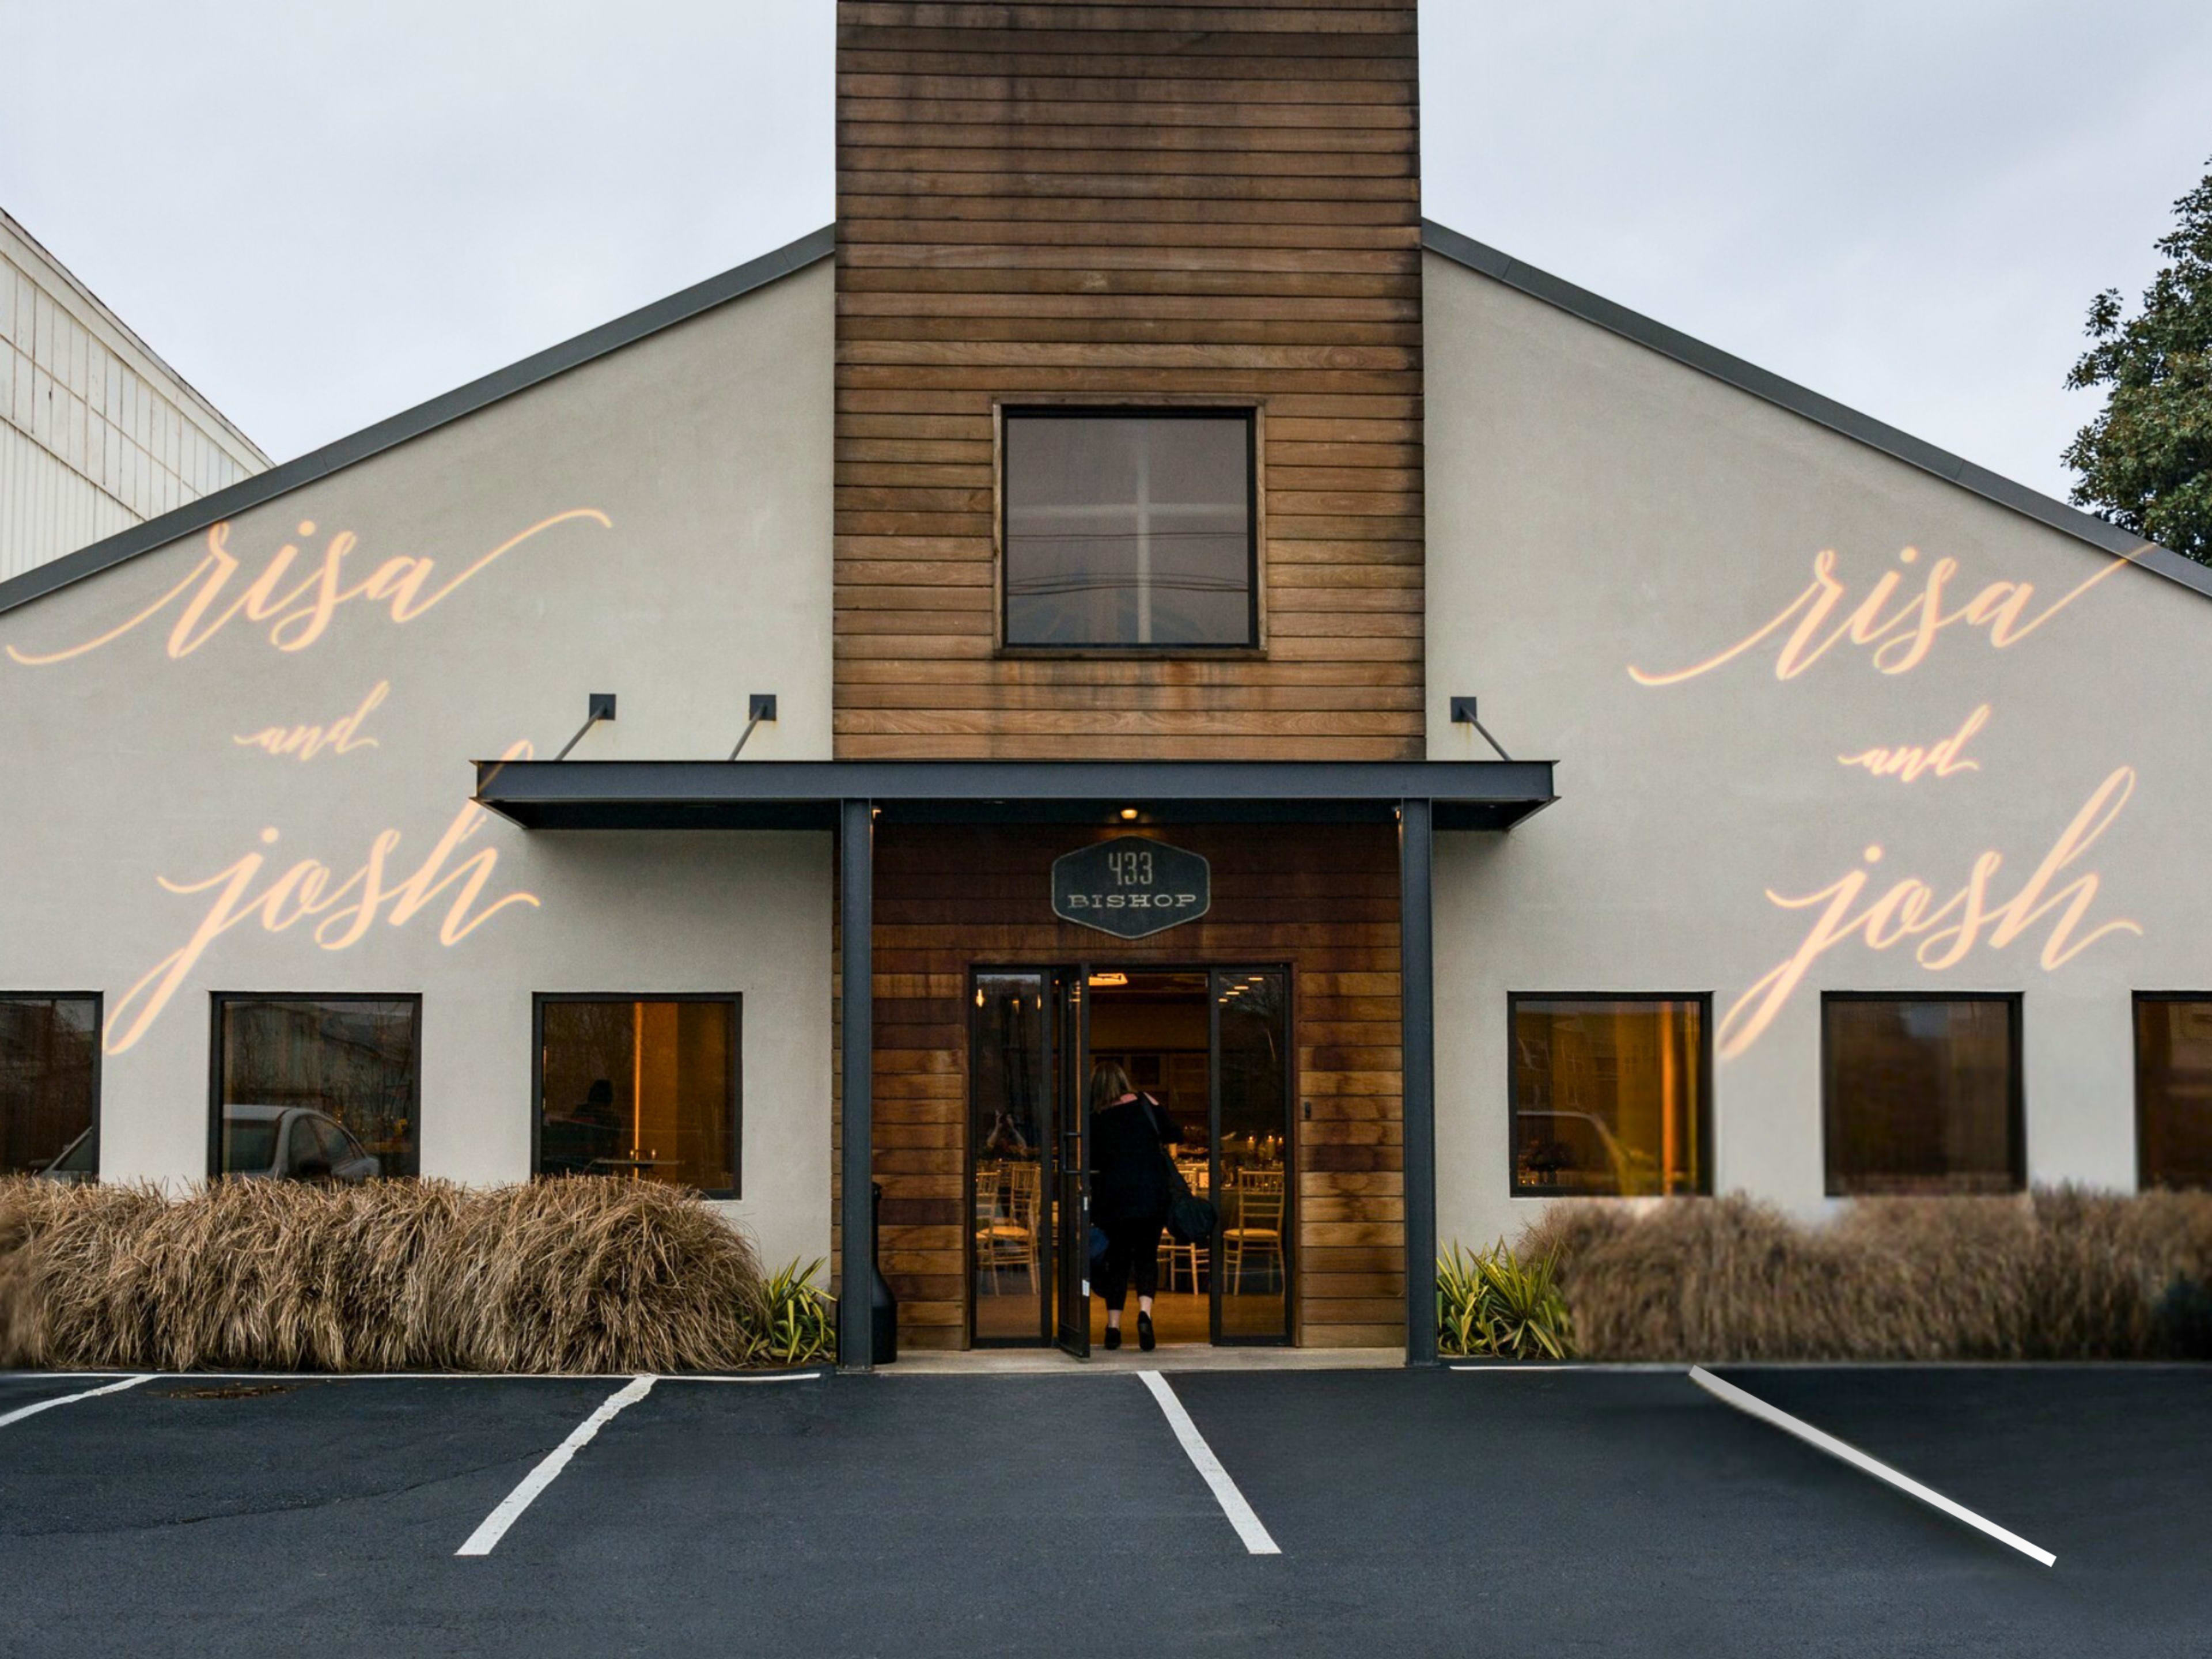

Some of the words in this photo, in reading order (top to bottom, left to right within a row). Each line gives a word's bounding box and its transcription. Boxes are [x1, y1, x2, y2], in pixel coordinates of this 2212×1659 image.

[6, 509, 612, 665] risa
[1627, 542, 2156, 685] risa
[233, 680, 391, 761] and
[1837, 703, 1991, 782] and
[103, 740, 540, 1055] josh
[1067, 894, 1196, 908] BISHOP
[1108, 851, 1153, 885] 433
[1717, 766, 2142, 1060] josh
